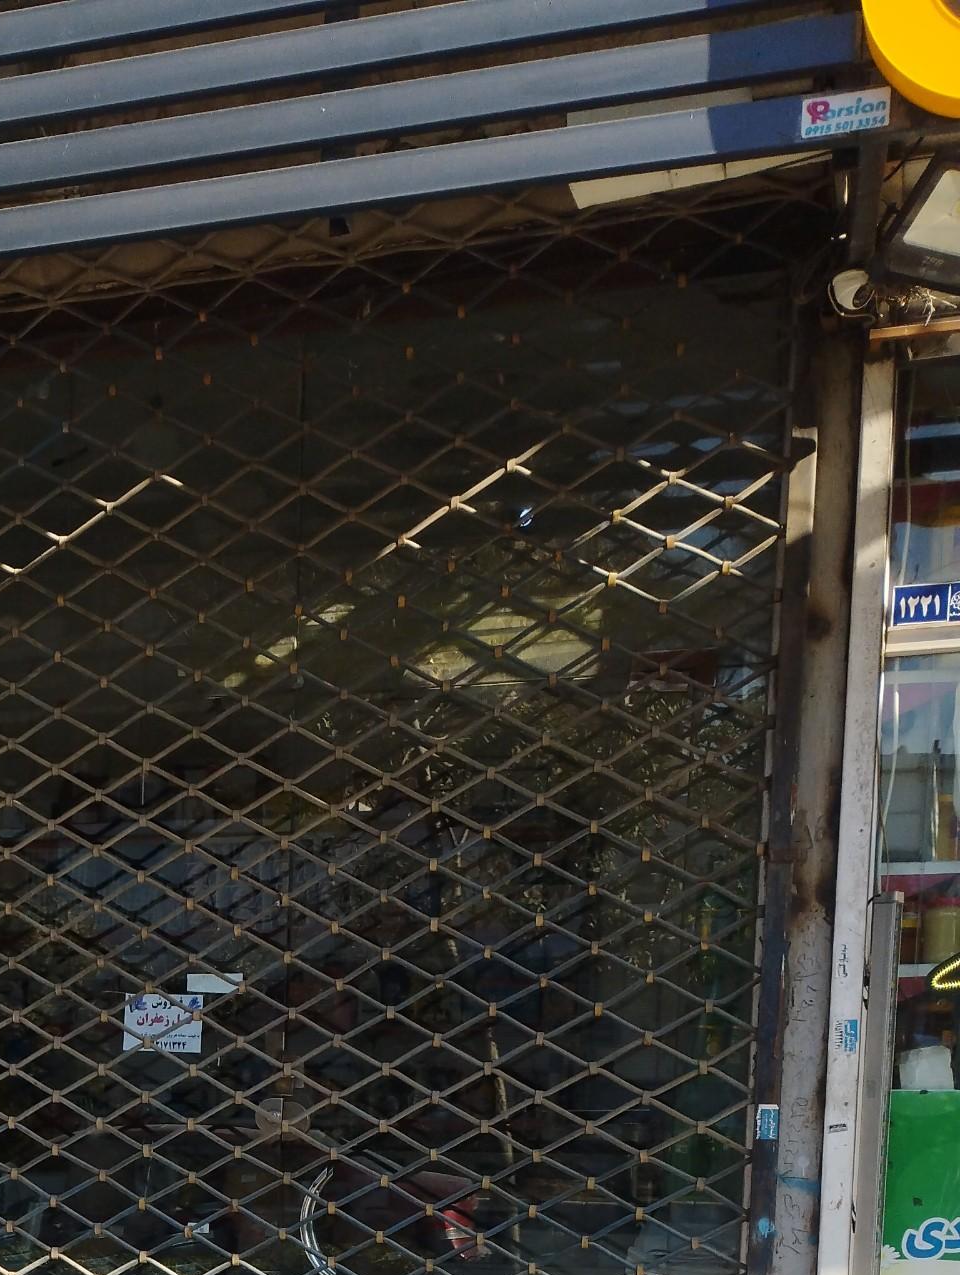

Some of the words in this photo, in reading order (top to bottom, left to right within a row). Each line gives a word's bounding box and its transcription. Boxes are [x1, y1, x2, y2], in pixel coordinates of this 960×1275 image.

[807, 97, 887, 124] Parsian
[805, 125, 832, 136] 0915
[835, 121, 854, 132] 501
[136, 1013, 170, 1027] زعفران
